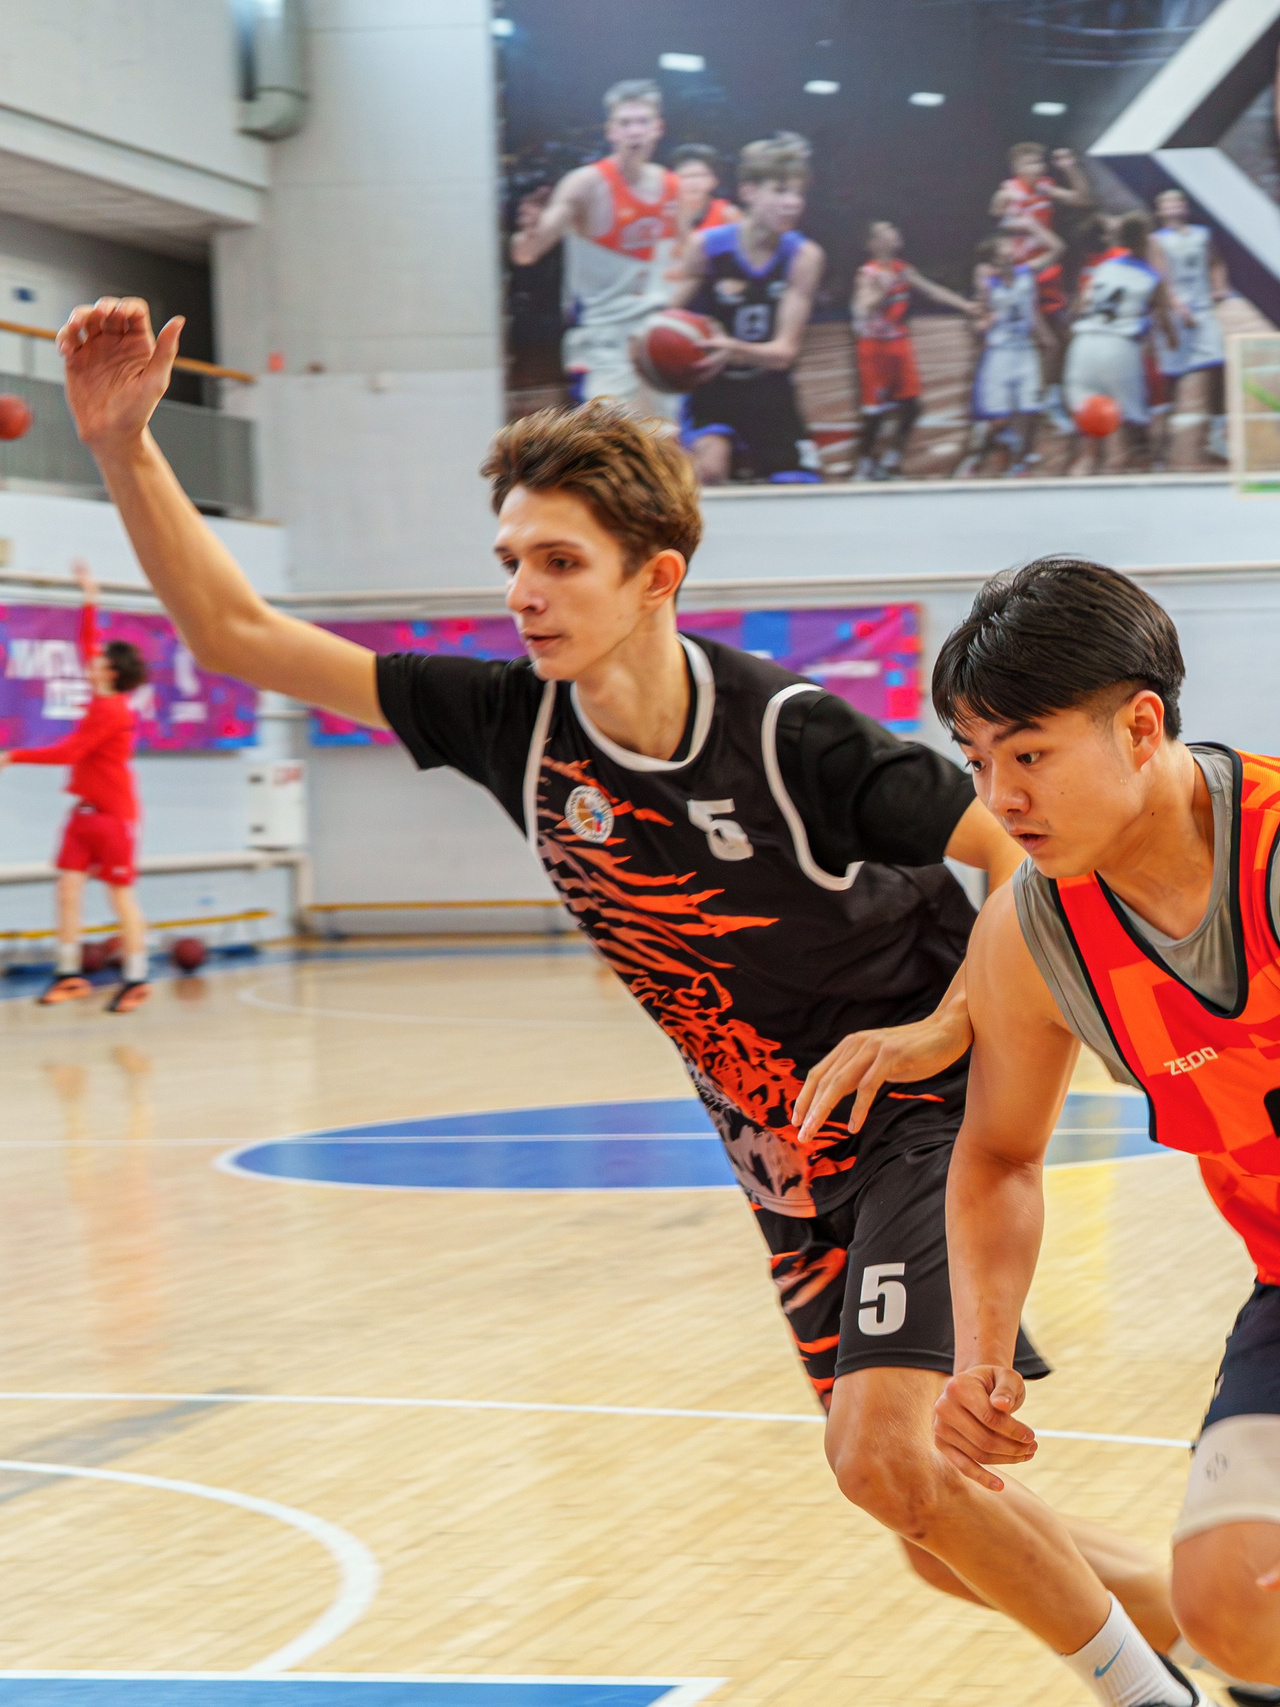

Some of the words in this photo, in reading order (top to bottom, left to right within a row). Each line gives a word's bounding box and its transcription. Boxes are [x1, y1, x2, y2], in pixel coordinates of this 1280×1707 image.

[686, 798, 755, 862] 5
[1163, 1046, 1219, 1076] ZEDO
[858, 1262, 907, 1337] 5
